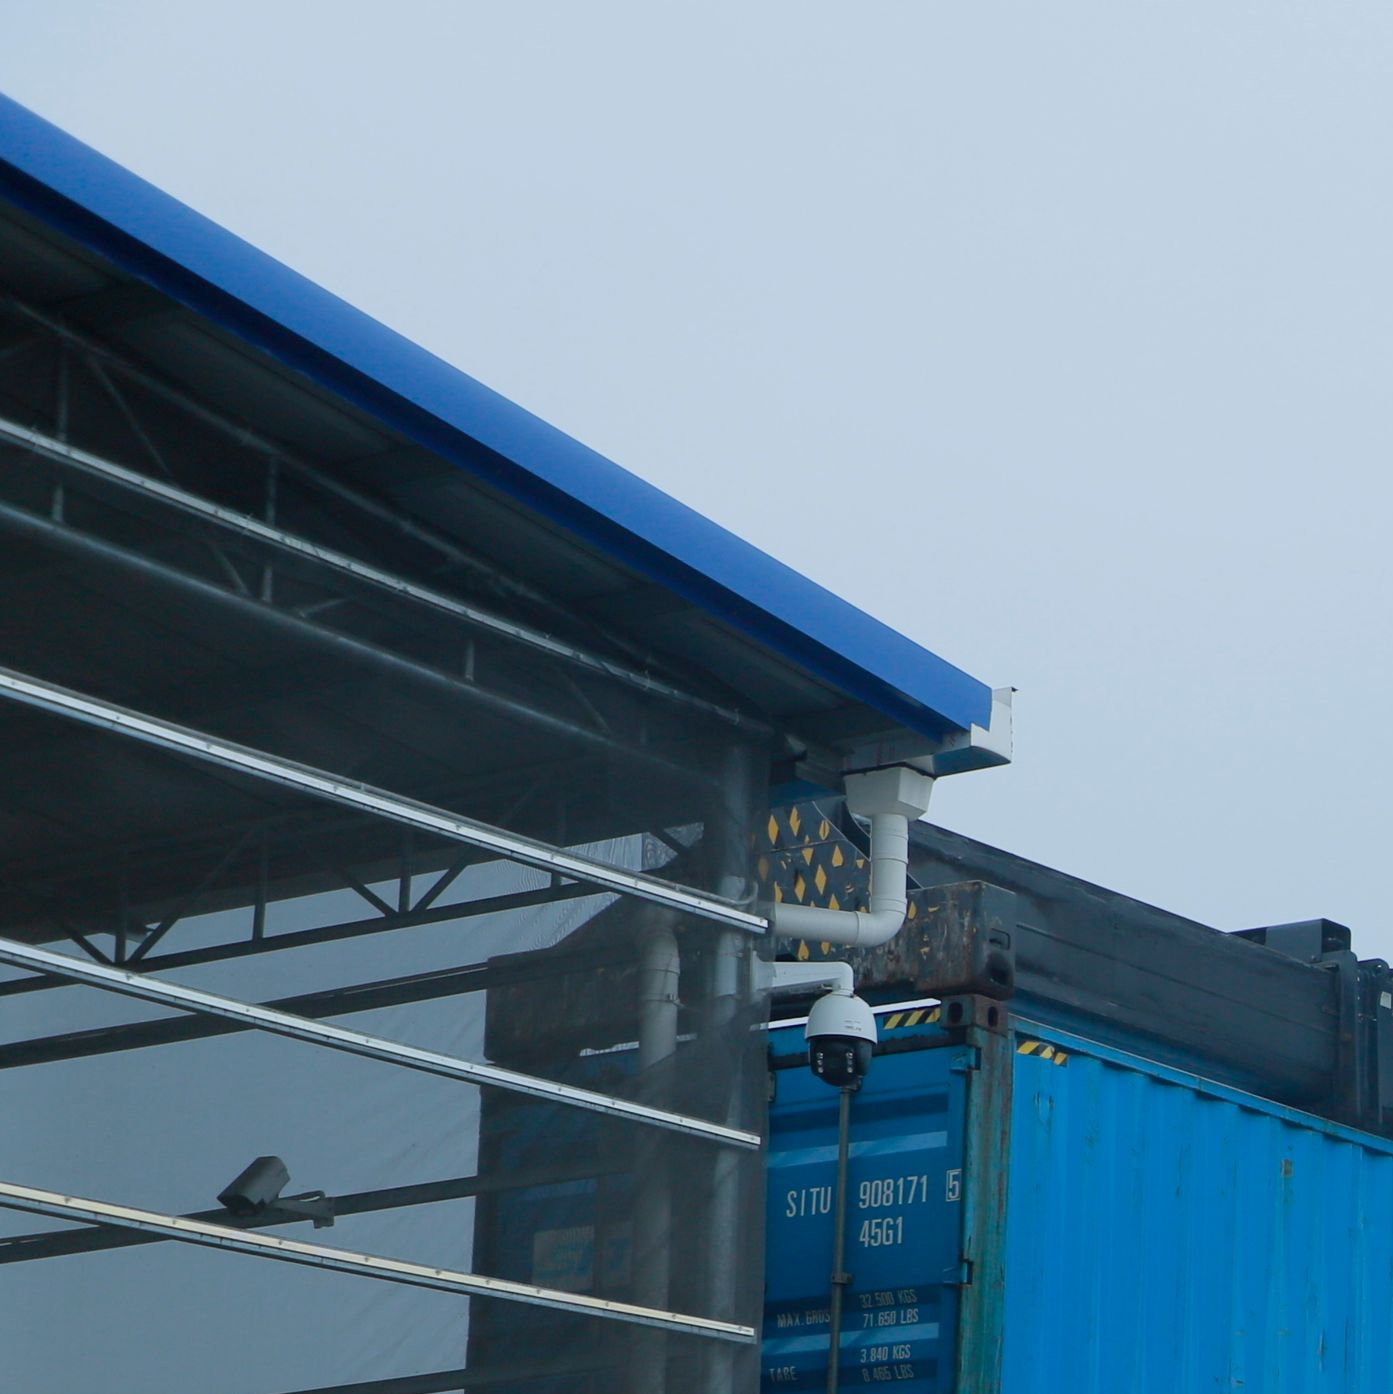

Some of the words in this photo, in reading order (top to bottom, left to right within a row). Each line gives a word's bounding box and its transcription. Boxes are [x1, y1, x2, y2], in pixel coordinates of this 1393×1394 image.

[785, 1186, 832, 1218] SITU
[858, 1174, 928, 1209] 908171
[947, 1170, 961, 1201] 5
[859, 1216, 904, 1248] 45G1
[862, 1310, 897, 1328] 71.650
[900, 1308, 919, 1325] LBS
[768, 1365, 799, 1383] TARE
[860, 1346, 889, 1363] 3.840
[892, 1344, 912, 1360] KGS
[895, 1364, 915, 1380] LBS
